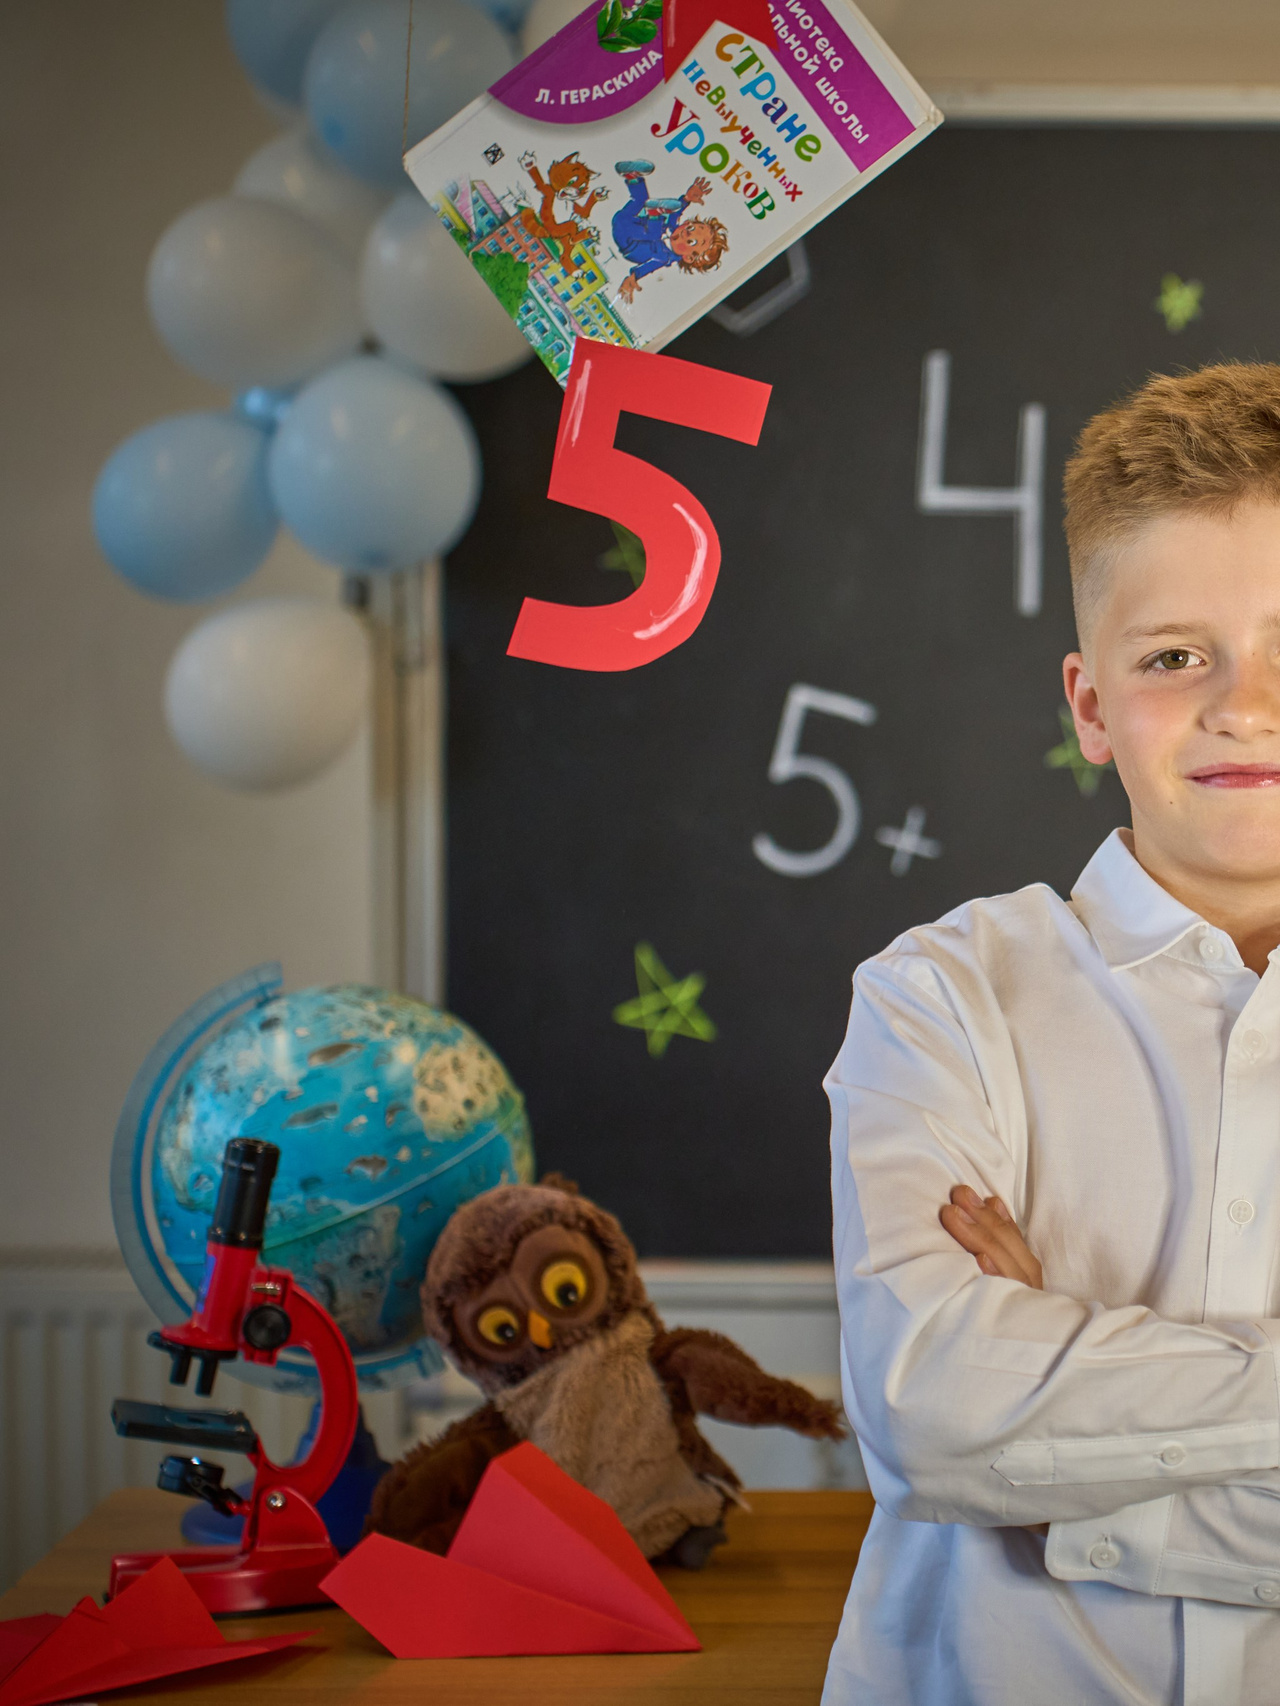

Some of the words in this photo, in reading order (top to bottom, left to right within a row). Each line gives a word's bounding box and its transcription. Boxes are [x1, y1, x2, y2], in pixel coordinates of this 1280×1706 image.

[785, 0, 844, 73] иотека
[535, 88, 555, 105] Л.
[561, 49, 664, 105] ГЕРАСКИНА
[815, 77, 870, 144] школы
[506, 336, 773, 672] 5
[918, 349, 1046, 617] 4
